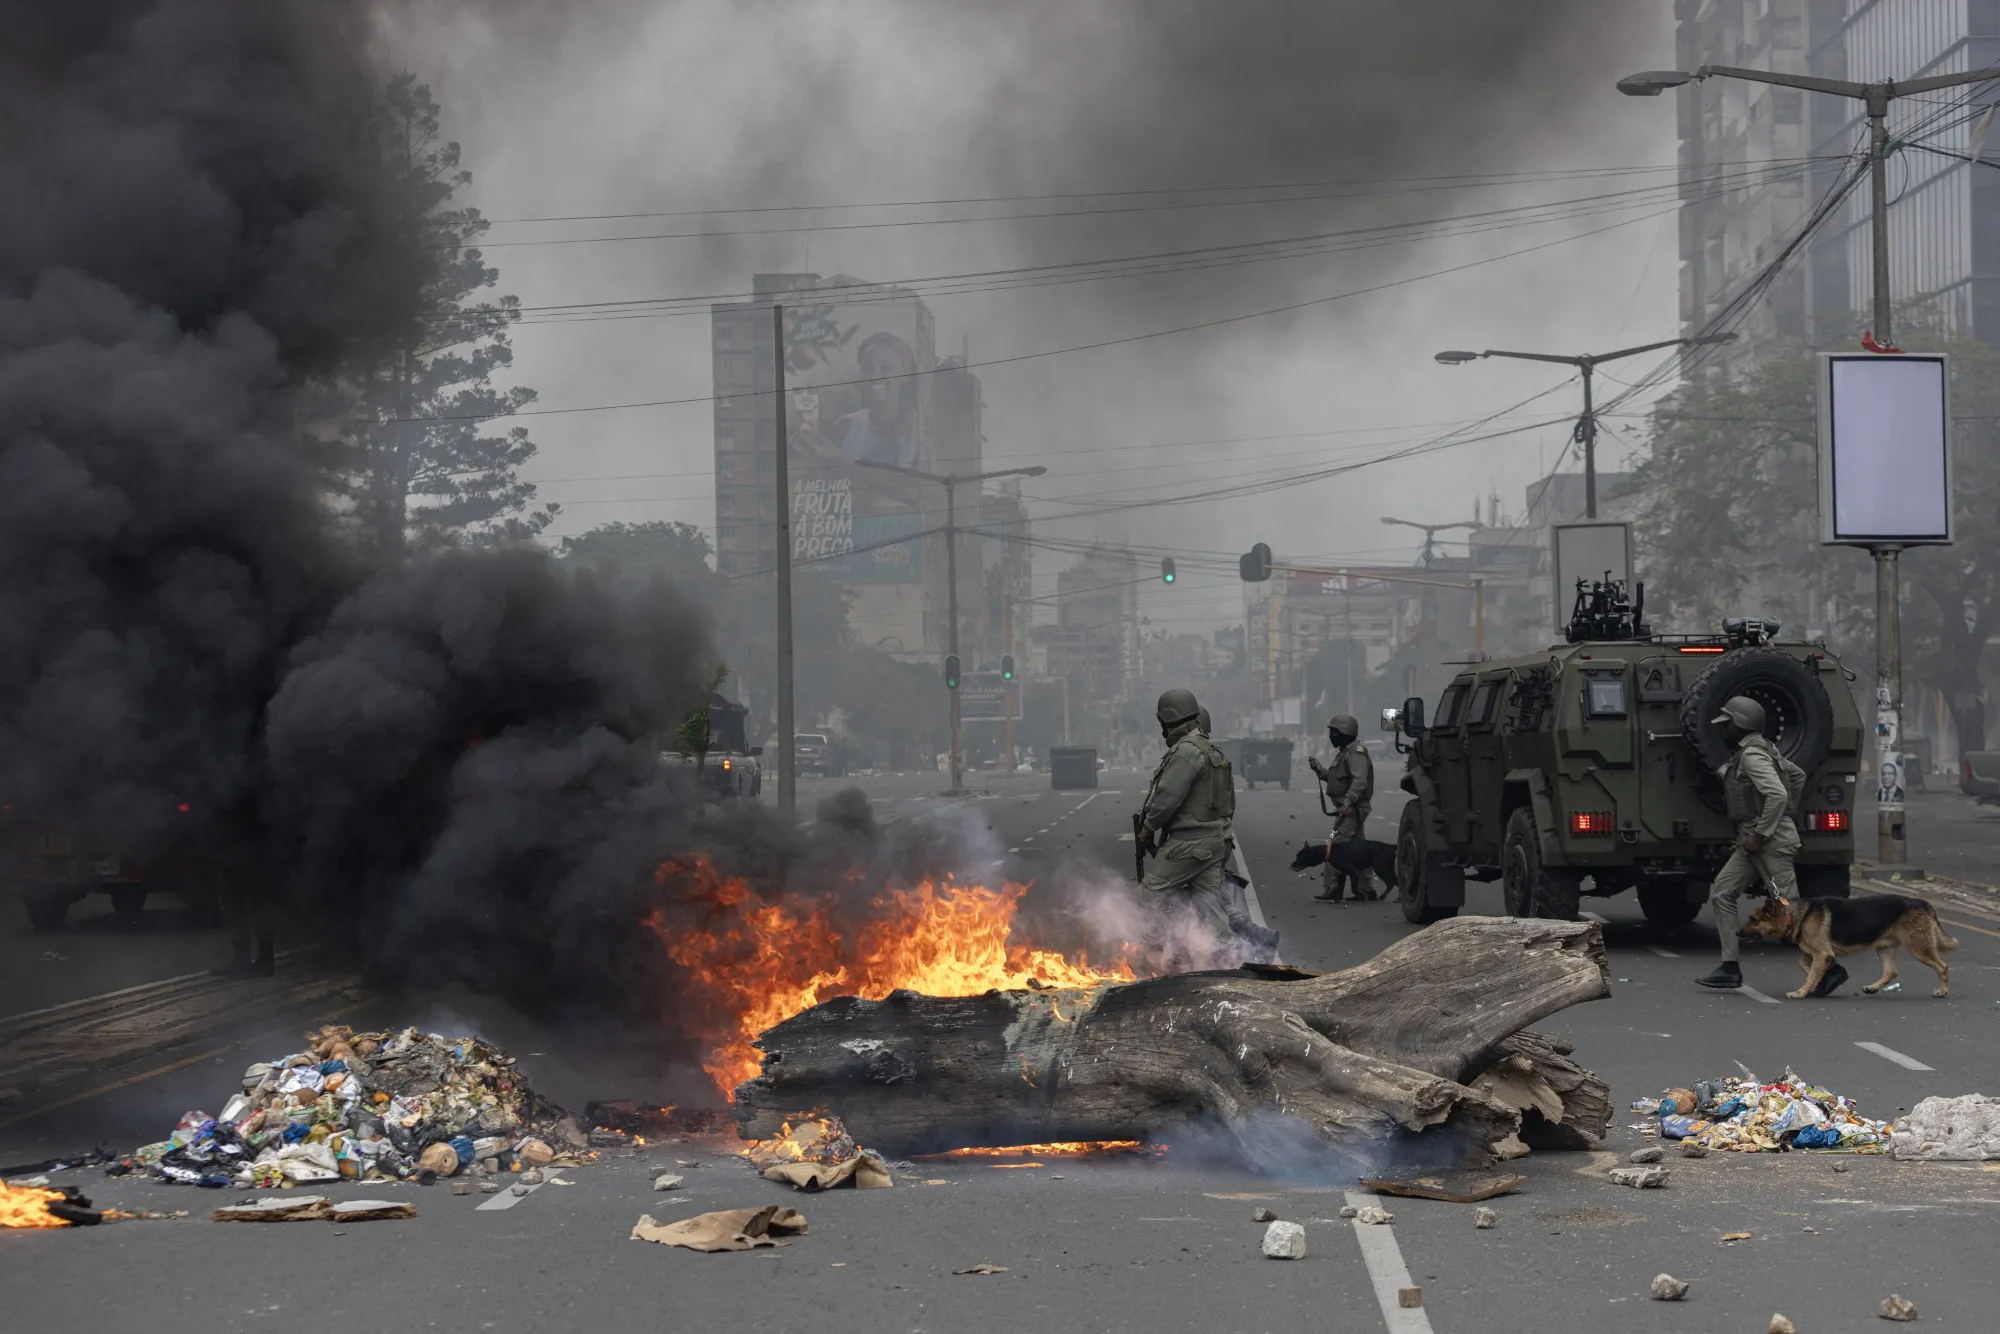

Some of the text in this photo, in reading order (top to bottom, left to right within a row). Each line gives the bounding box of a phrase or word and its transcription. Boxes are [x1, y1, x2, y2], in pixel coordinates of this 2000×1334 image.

[794, 478, 852, 493] A MELHOR
[794, 492, 852, 514] FRUTA
[794, 514, 853, 537] A BOM
